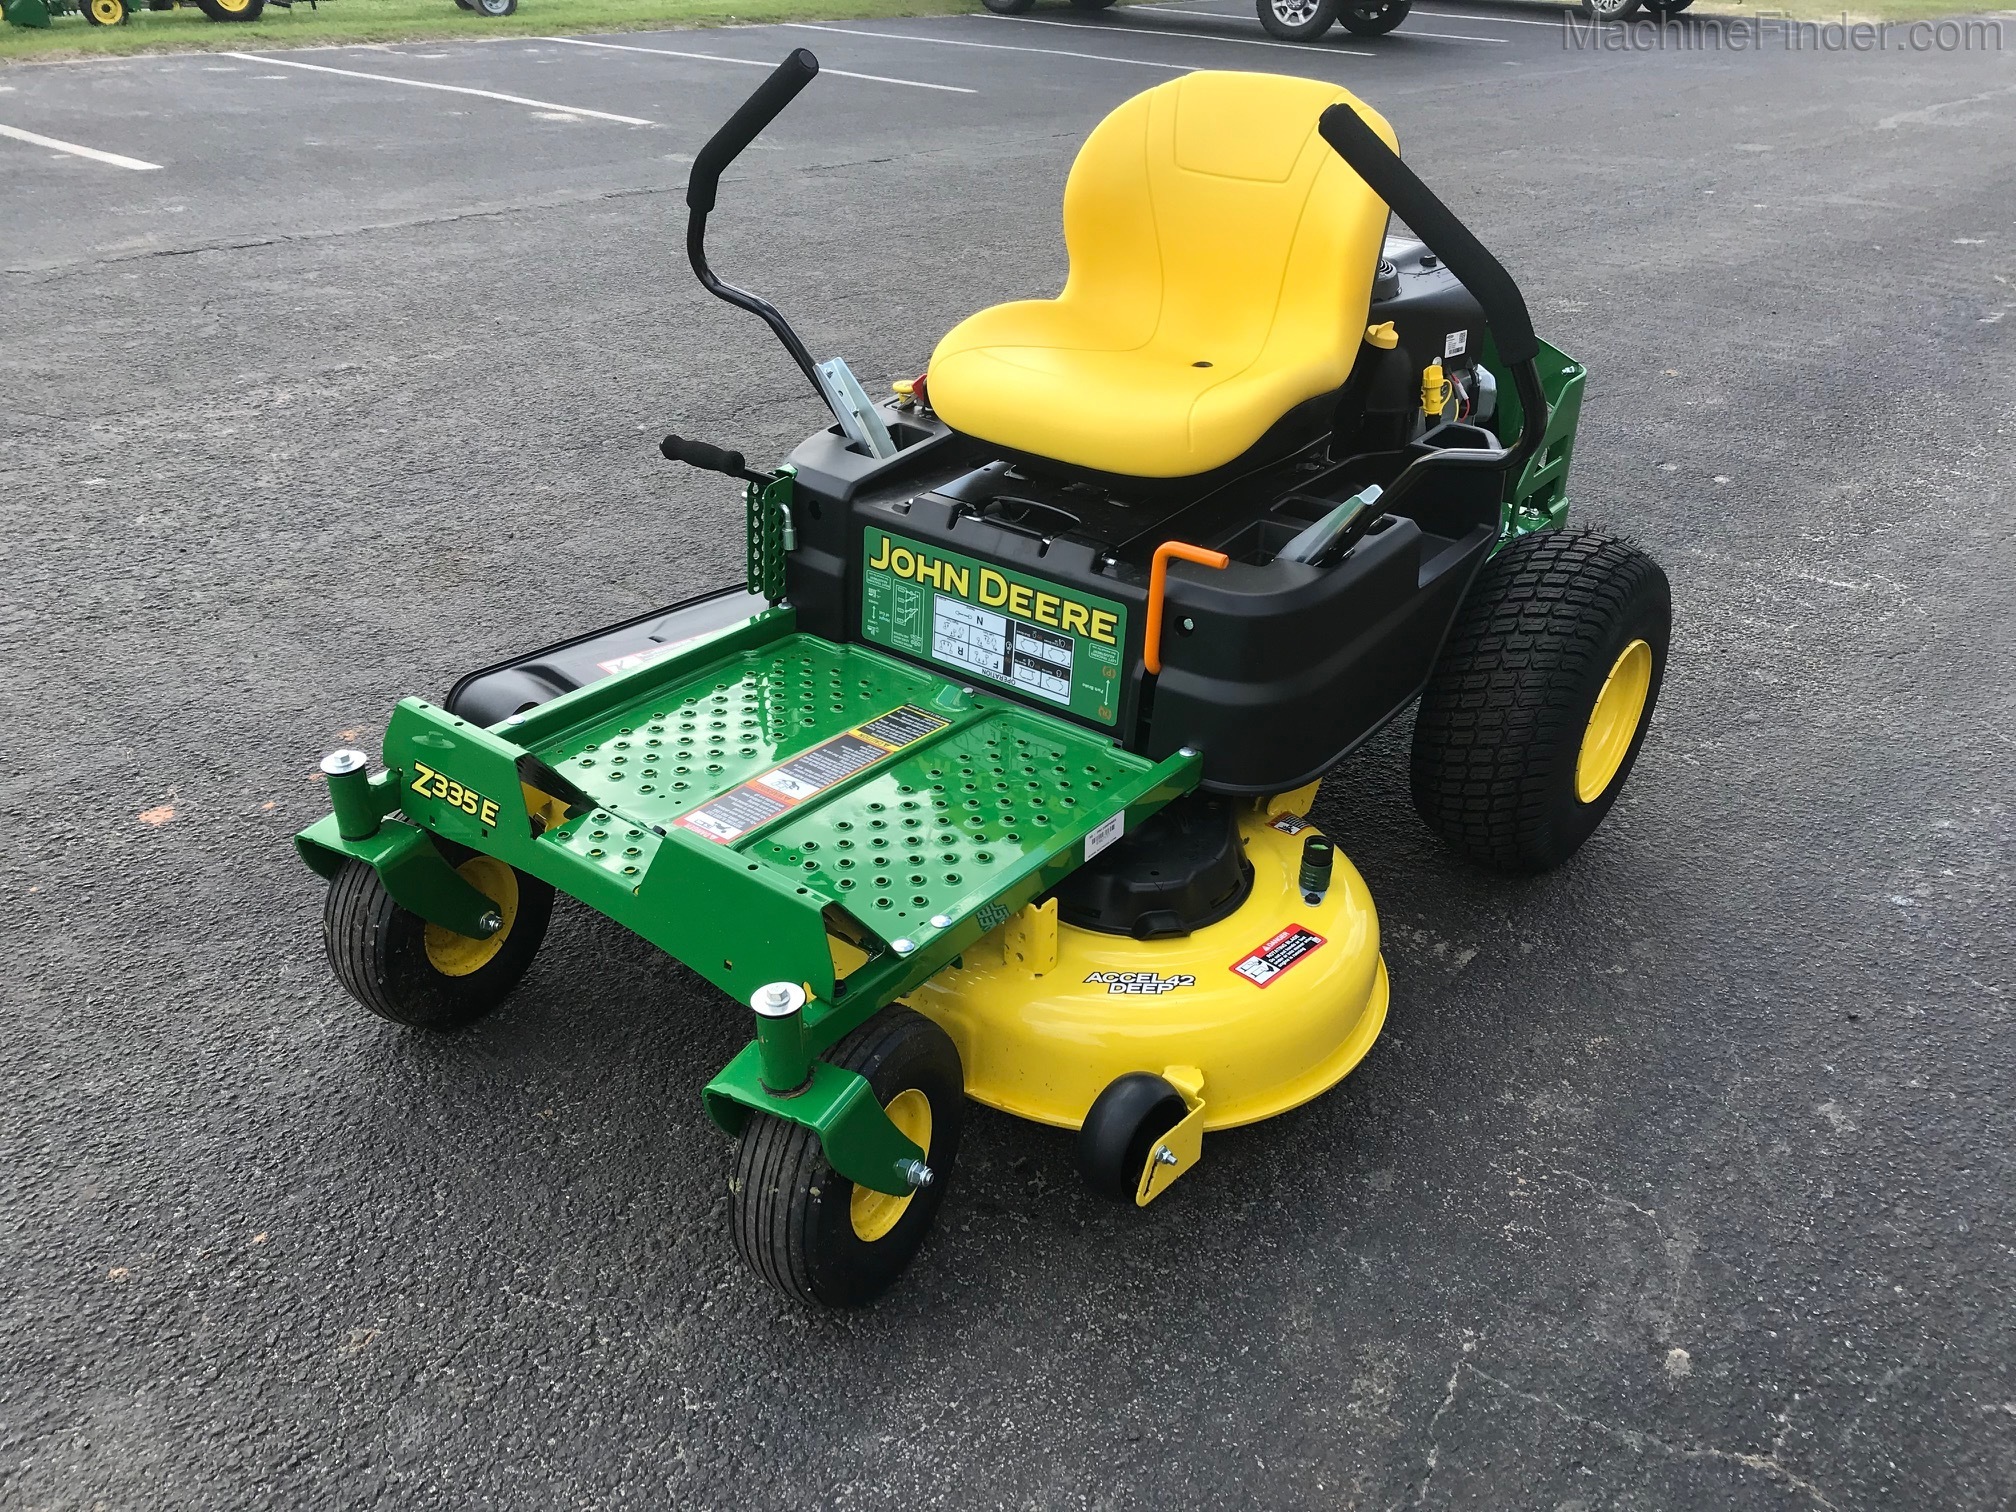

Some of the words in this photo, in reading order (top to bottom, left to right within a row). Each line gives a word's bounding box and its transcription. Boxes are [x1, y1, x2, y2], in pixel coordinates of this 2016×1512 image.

[869, 536, 969, 597] JOHN
[978, 565, 1118, 645] DEERE
[975, 614, 984, 625] N
[955, 645, 964, 656] R
[991, 658, 999, 669] F
[980, 668, 1017, 686] OPERATION
[1267, 931, 1290, 948] DANGER
[1083, 972, 1165, 984] ACCEL
[1164, 975, 1196, 987] 42
[1108, 983, 1174, 994] DEEP
